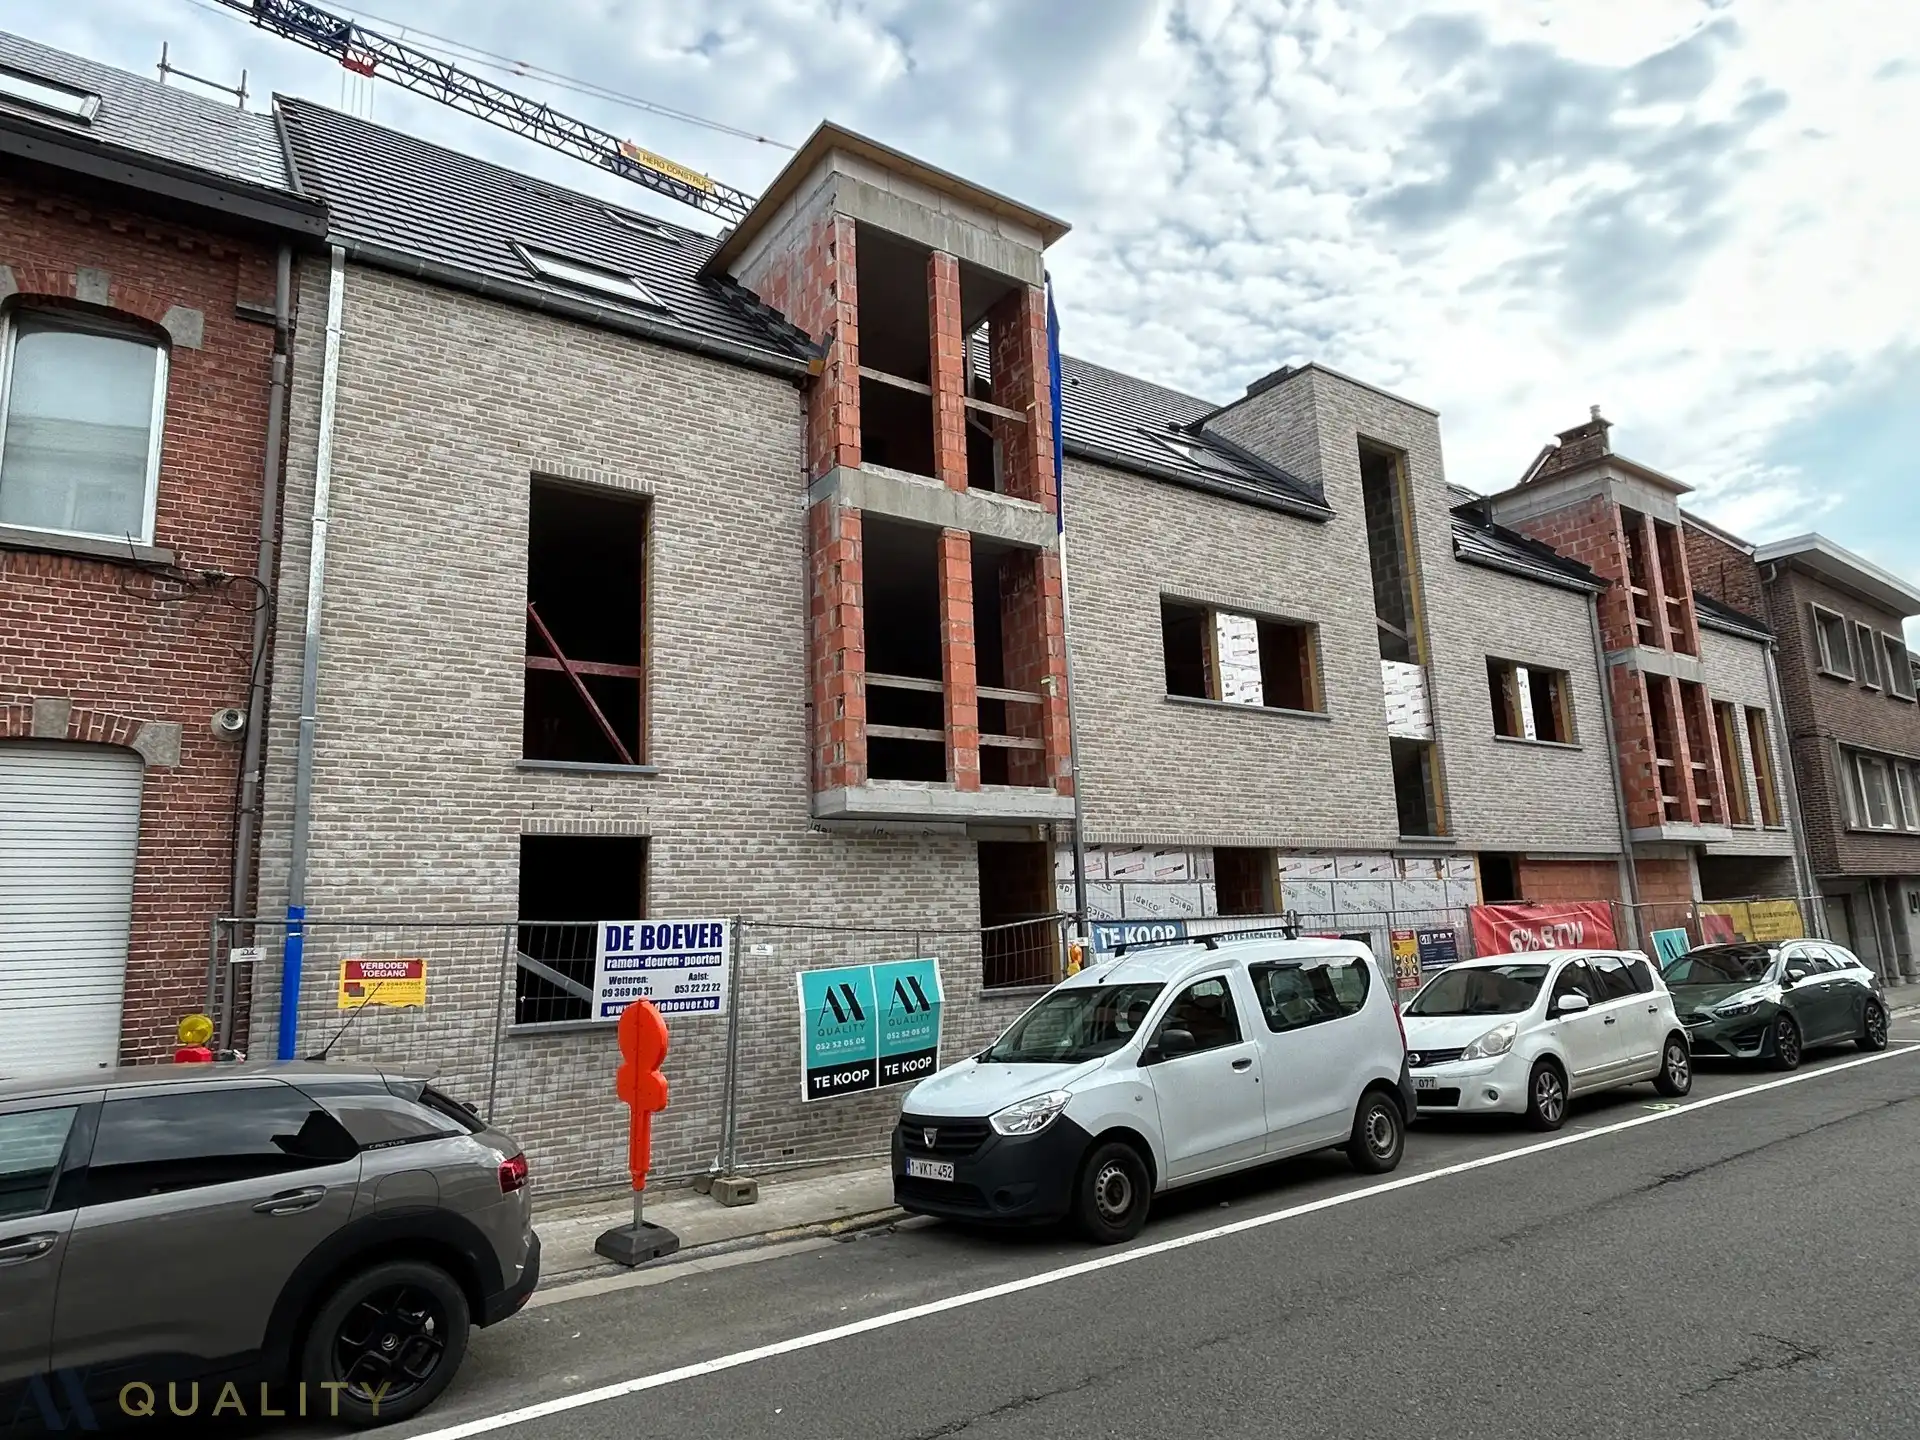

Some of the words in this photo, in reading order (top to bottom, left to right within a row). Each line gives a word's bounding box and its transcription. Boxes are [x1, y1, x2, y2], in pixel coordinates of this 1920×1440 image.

[642, 153, 665, 170] HERO
[666, 164, 714, 190] CONSTRUCT
[604, 925, 635, 952] DE
[640, 923, 723, 951] BOEVER
[1097, 927, 1122, 949] TE
[1124, 925, 1177, 947] KOOP
[1509, 928, 1540, 953] 6%
[1540, 921, 1584, 949] BTW
[360, 962, 409, 970] VERBODEN
[606, 958, 639, 969] ramen
[644, 956, 679, 967] deuren
[684, 954, 721, 967] poorten
[608, 976, 649, 985] Wetteren:
[688, 972, 709, 981] Aalst:
[602, 988, 613, 998] 09
[614, 987, 631, 997] 369
[632, 987, 642, 997] 00
[643, 986, 653, 996] 31
[674, 984, 690, 994] 053
[690, 984, 700, 993] 22
[701, 983, 711, 992] 22
[711, 983, 721, 992] 22
[888, 1013, 931, 1027] QUALITY
[817, 1023, 866, 1037] QUALITY
[886, 1031, 900, 1040] 052
[901, 1030, 911, 1038] 52
[911, 1028, 920, 1036] 05
[921, 1026, 930, 1034] 05
[815, 1043, 830, 1051] 052
[832, 1040, 842, 1049] 52
[843, 1038, 854, 1047] 05
[855, 1037, 866, 1045] 05
[884, 1063, 899, 1077] TE
[901, 1056, 932, 1073] KOOP
[813, 1076, 831, 1089] TE
[833, 1068, 870, 1086] KOOP
[368, 1140, 406, 1150] CACTUS
[911, 1161, 953, 1179] 1-VKT-452
